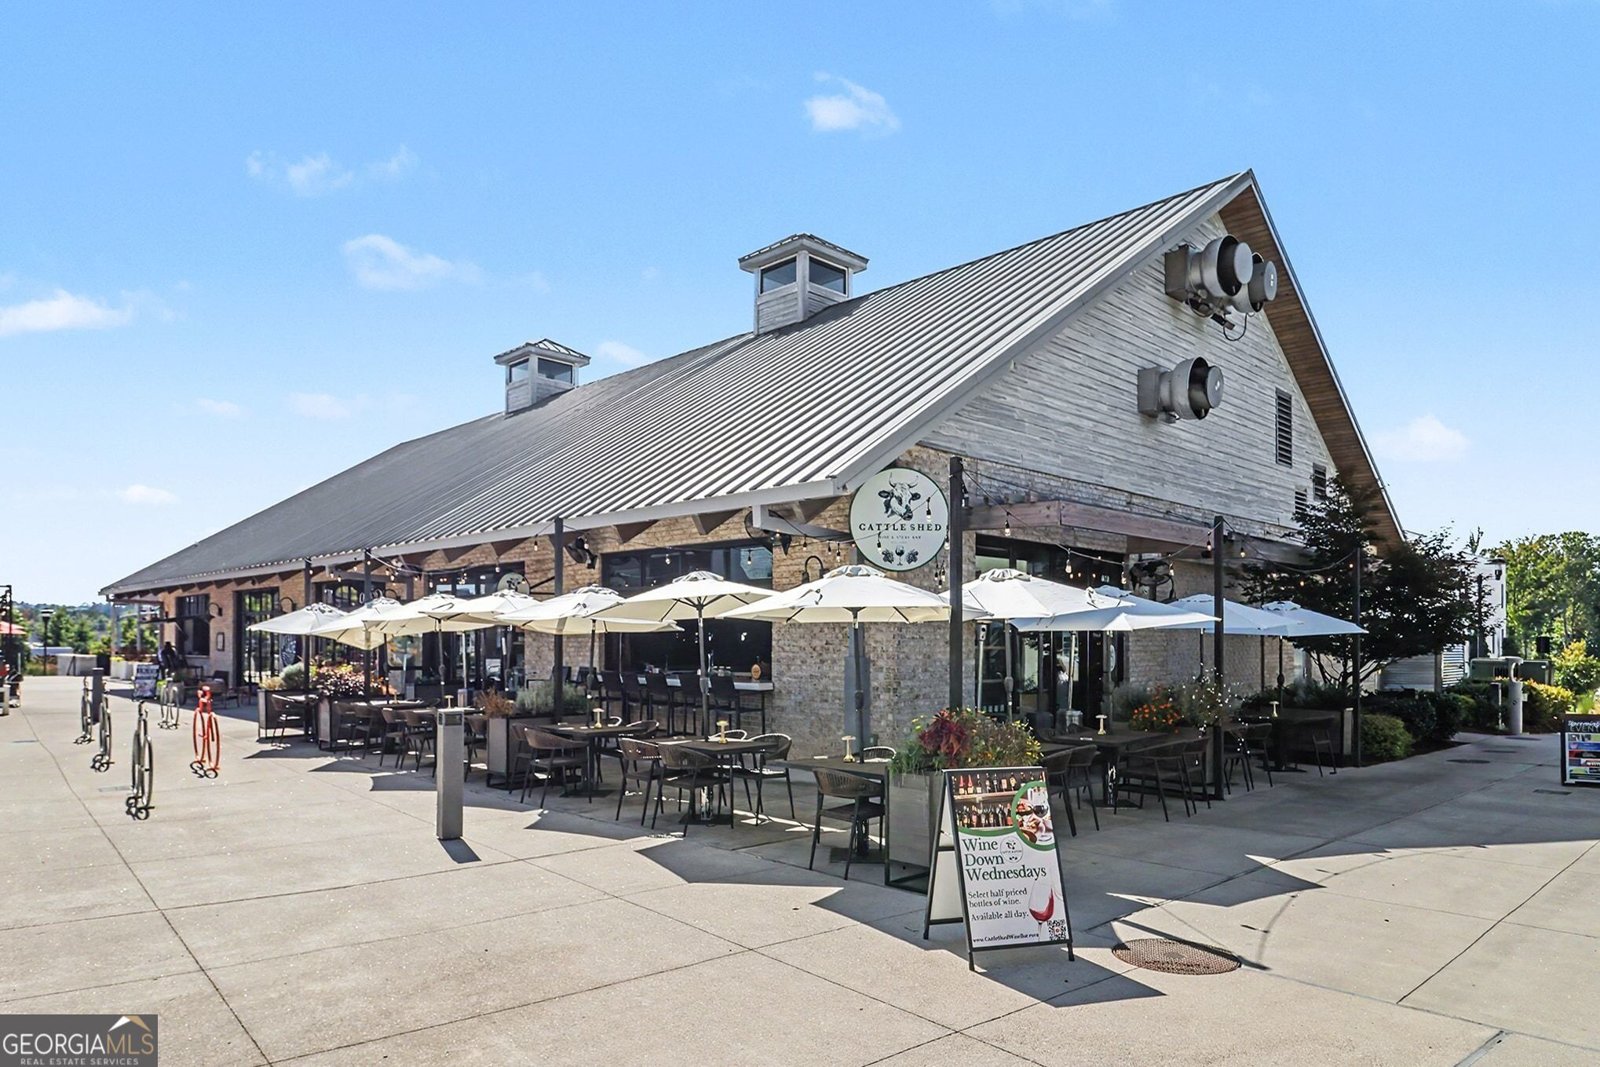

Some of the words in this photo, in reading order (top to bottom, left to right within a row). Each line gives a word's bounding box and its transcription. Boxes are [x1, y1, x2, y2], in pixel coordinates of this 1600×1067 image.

[859, 523, 906, 531] CATTLE
[910, 523, 942, 531] SHED
[962, 838, 998, 852] Wine
[965, 853, 1005, 867] Down
[966, 864, 1047, 881] Wednesdays
[968, 890, 989, 898] Select
[990, 888, 1004, 897] half
[1005, 887, 1027, 898] priced
[969, 899, 992, 907] bottles
[993, 898, 1002, 906] of
[971, 911, 1002, 920] Available
[1004, 910, 1013, 918] all
[1014, 910, 1029, 919] day.
